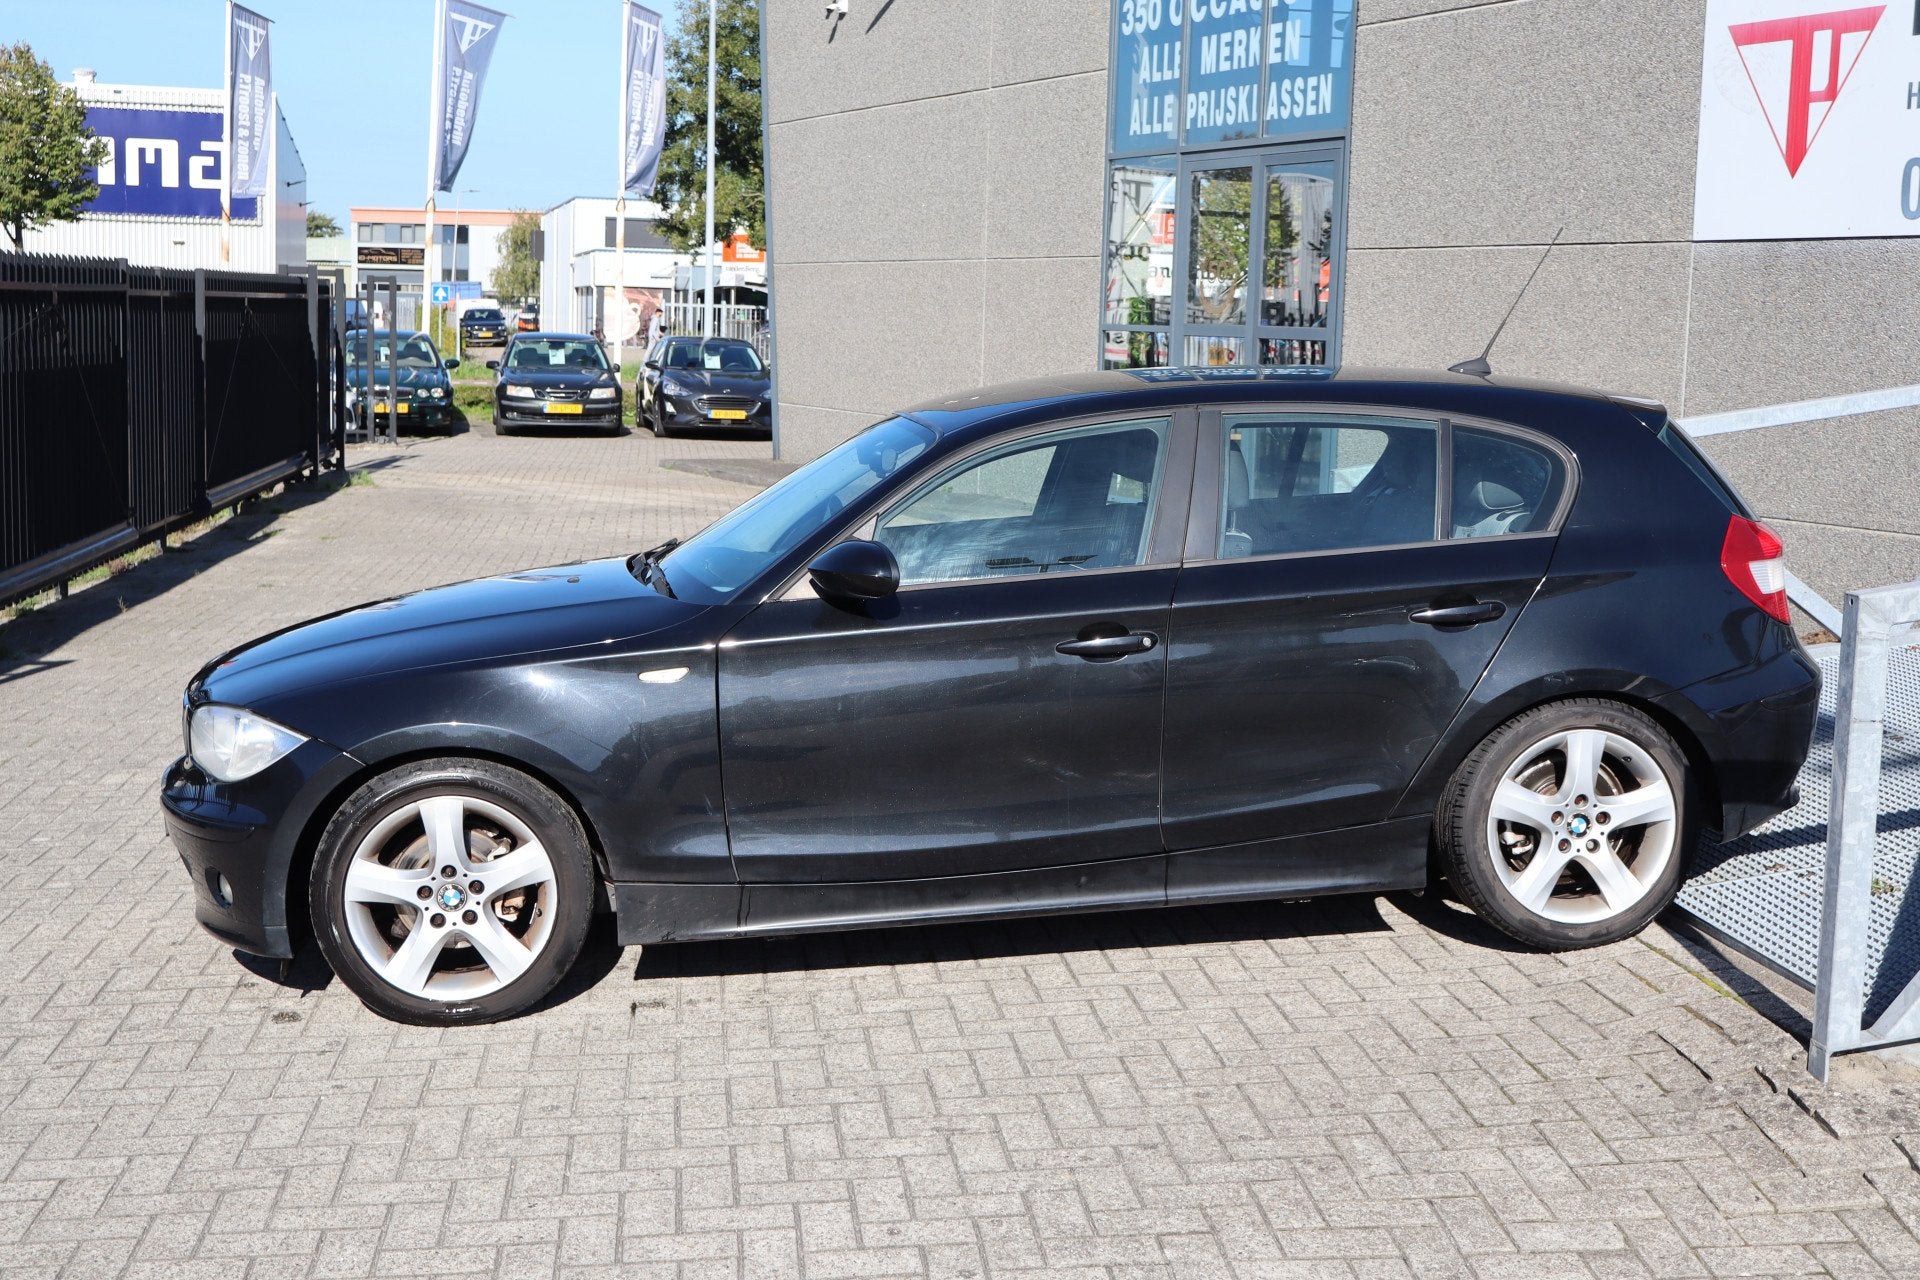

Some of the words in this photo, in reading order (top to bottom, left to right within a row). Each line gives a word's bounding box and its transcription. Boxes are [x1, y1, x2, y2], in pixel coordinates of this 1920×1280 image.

[1121, 0, 1162, 36] 350
[1139, 40, 1182, 84] ALLE
[1200, 19, 1301, 75] MERKEN
[238, 73, 251, 127] P.Troost
[1129, 94, 1174, 136] ALLE
[237, 138, 250, 181] zonen
